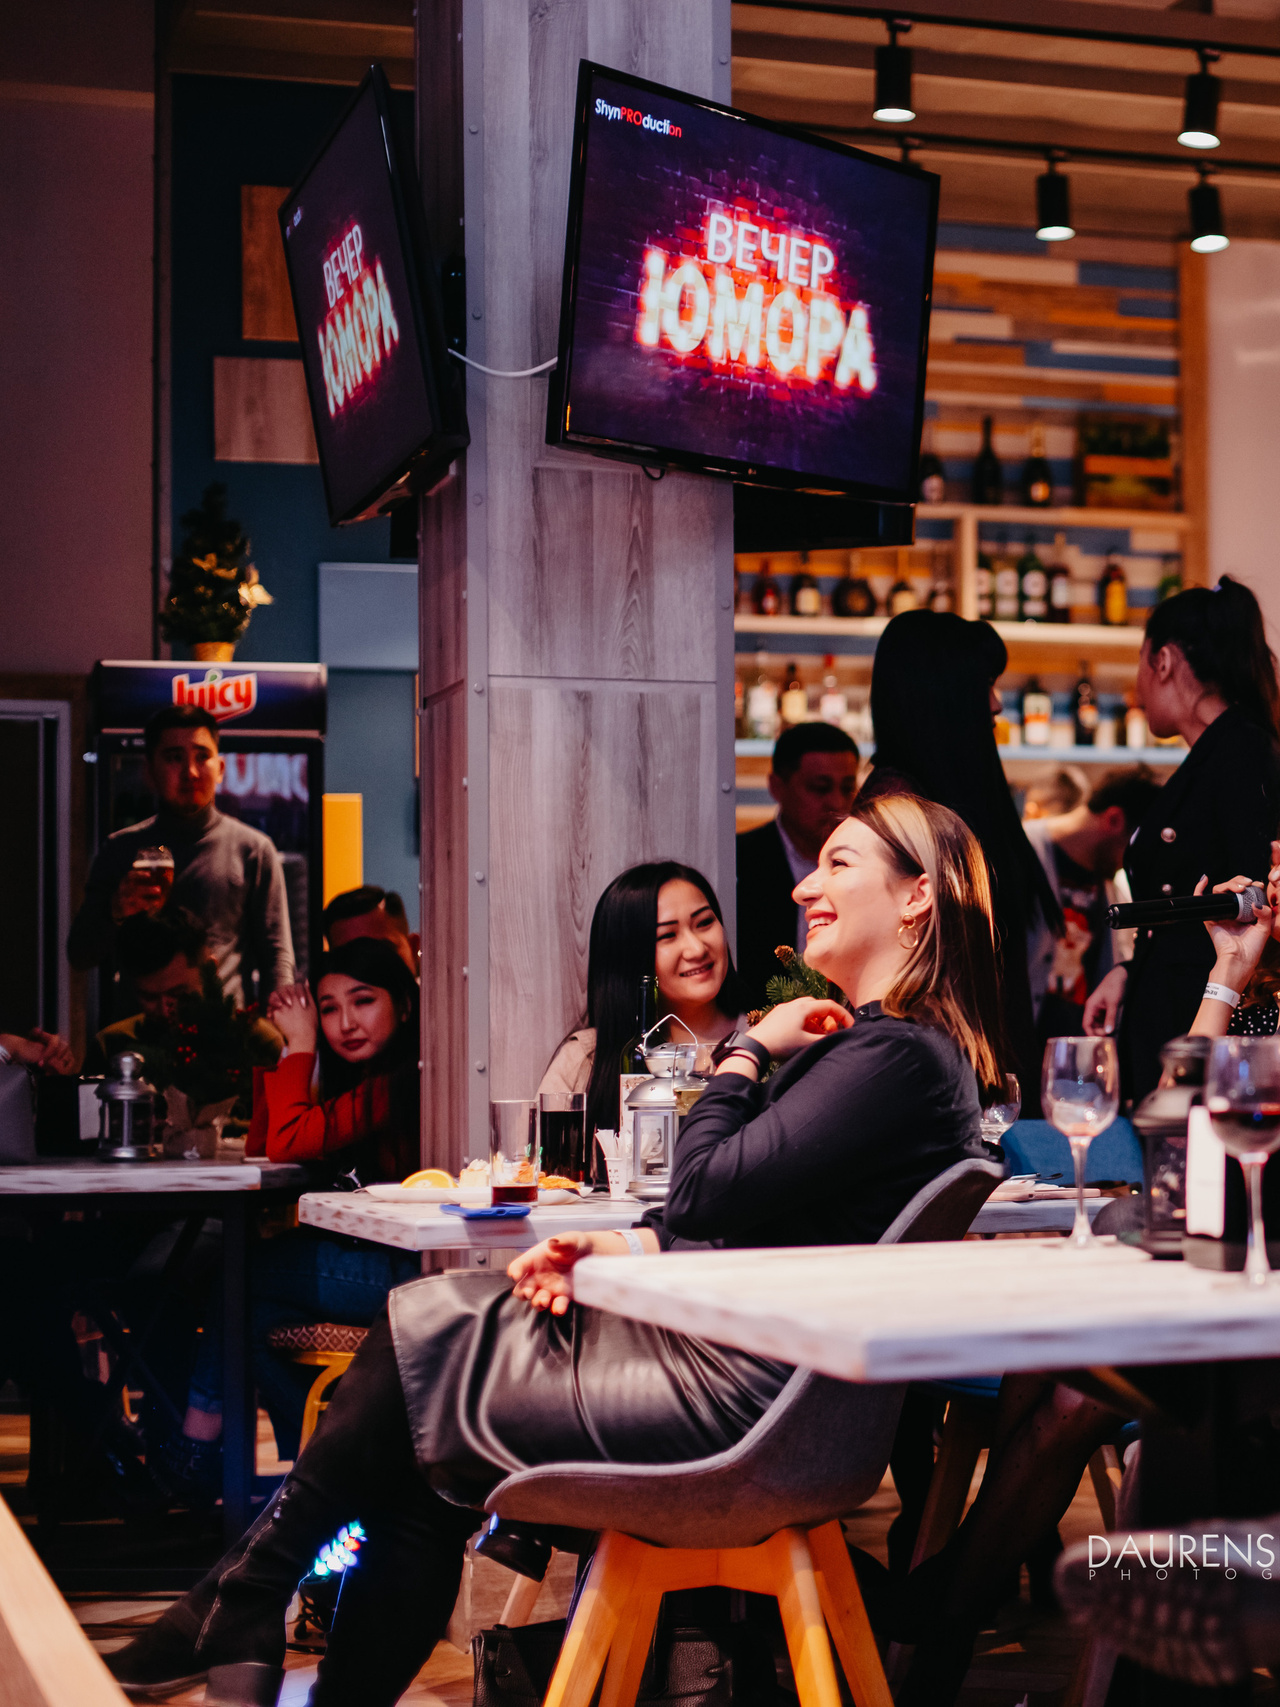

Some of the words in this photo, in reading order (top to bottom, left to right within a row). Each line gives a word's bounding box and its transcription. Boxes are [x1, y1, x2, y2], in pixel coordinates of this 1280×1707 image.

[595, 98, 682, 138] ShynPROduction
[323, 224, 363, 310] ВЕЧЕР
[707, 212, 834, 289] ВЕЧЕР
[318, 258, 399, 418] ЮМОРА
[639, 249, 877, 391] ЮМОРА
